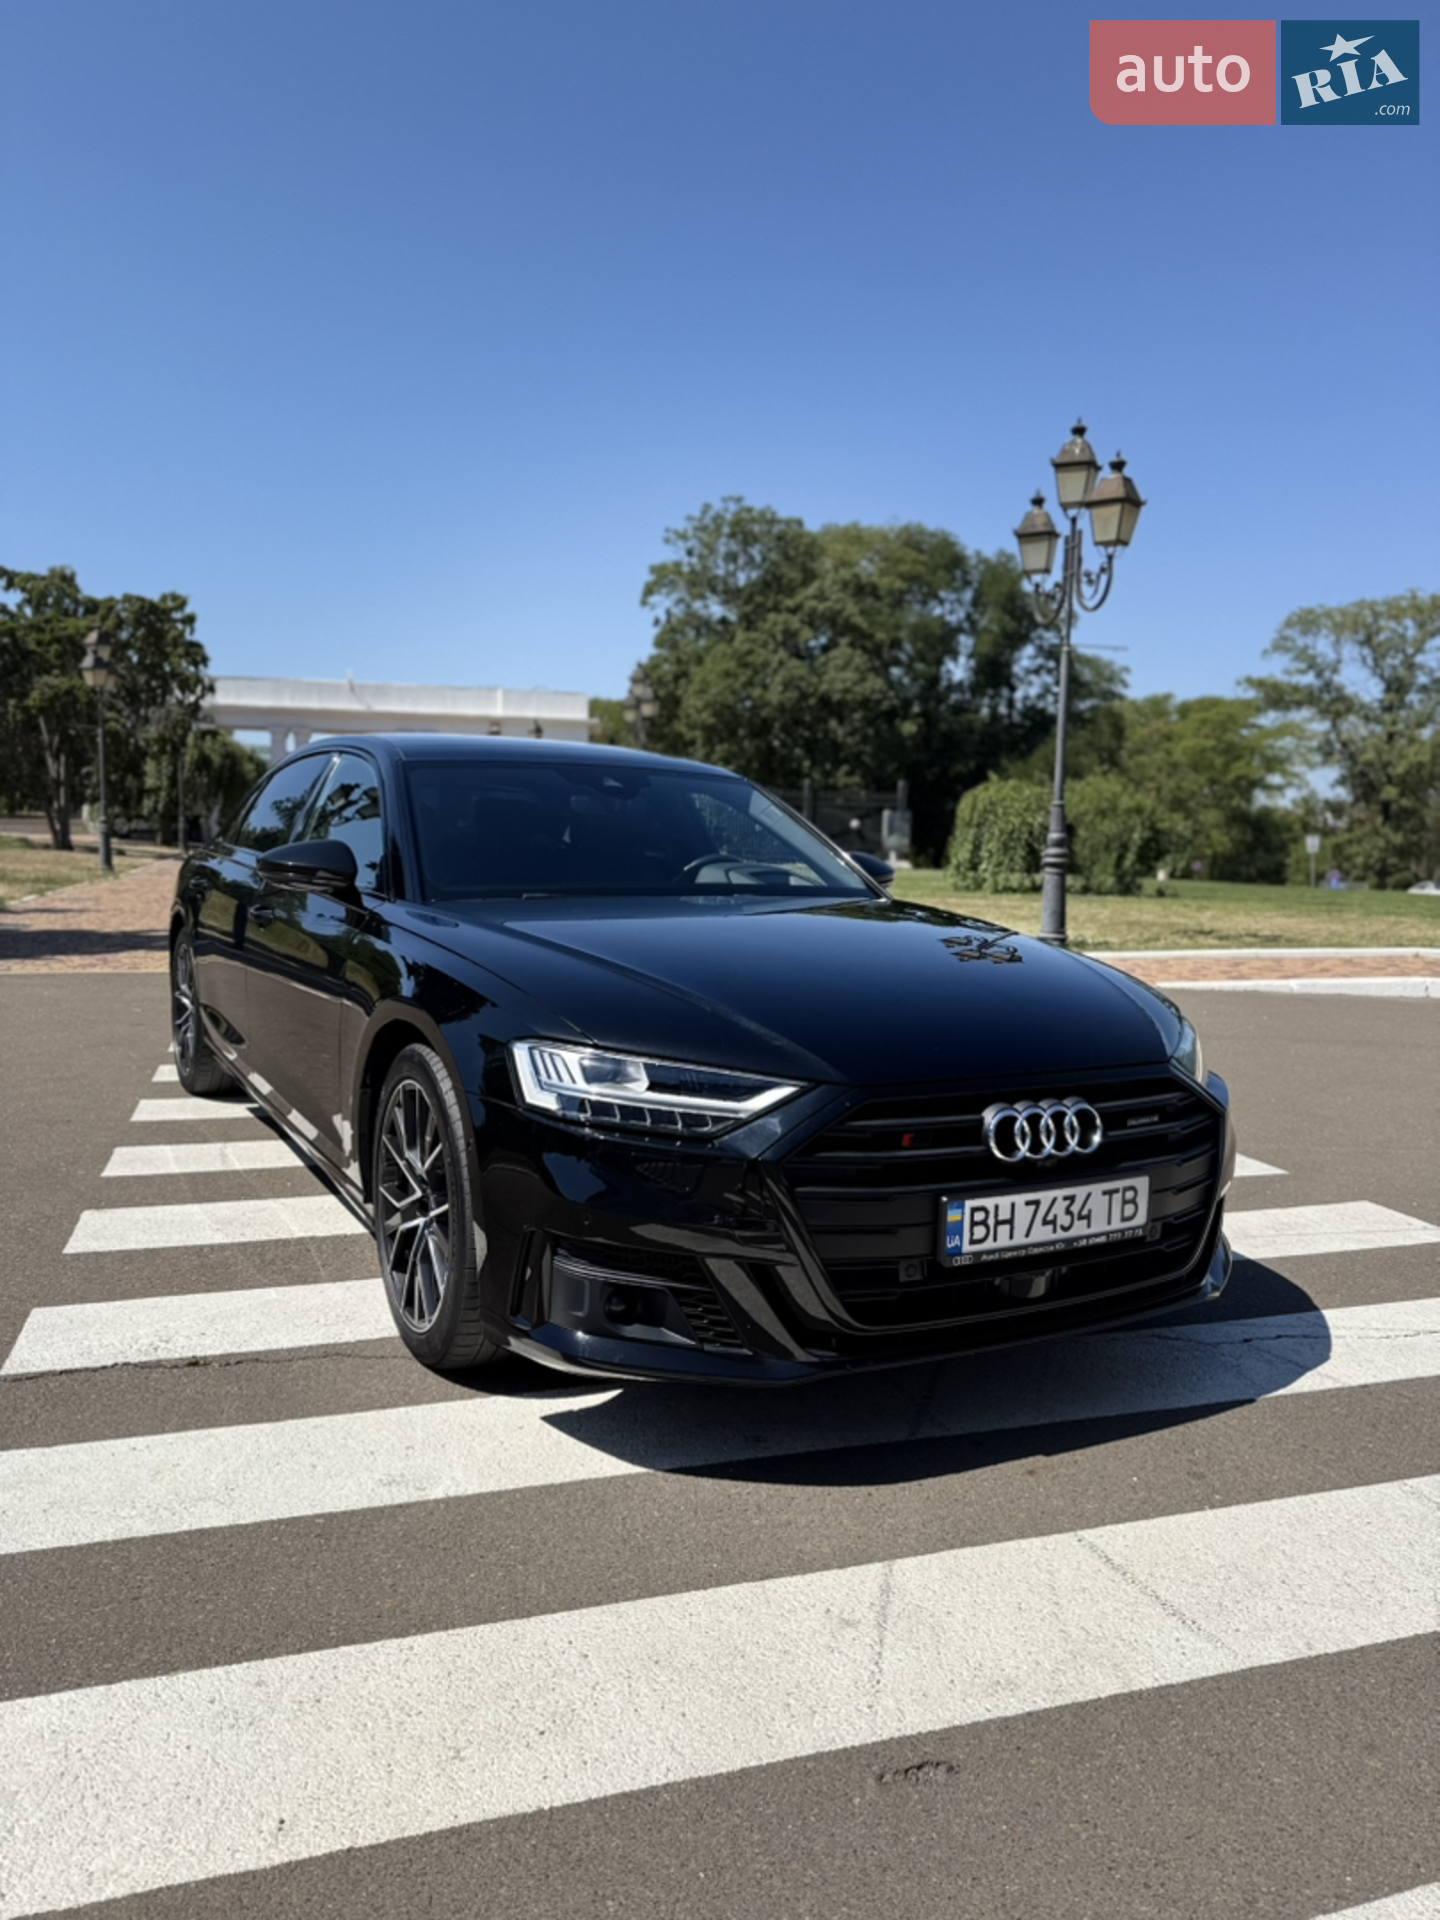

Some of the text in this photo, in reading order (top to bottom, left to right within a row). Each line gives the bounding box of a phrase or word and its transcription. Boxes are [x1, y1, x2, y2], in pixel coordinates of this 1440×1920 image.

[969, 1185, 1138, 1245] BH 7434 TB
[946, 1234, 961, 1249] UA
